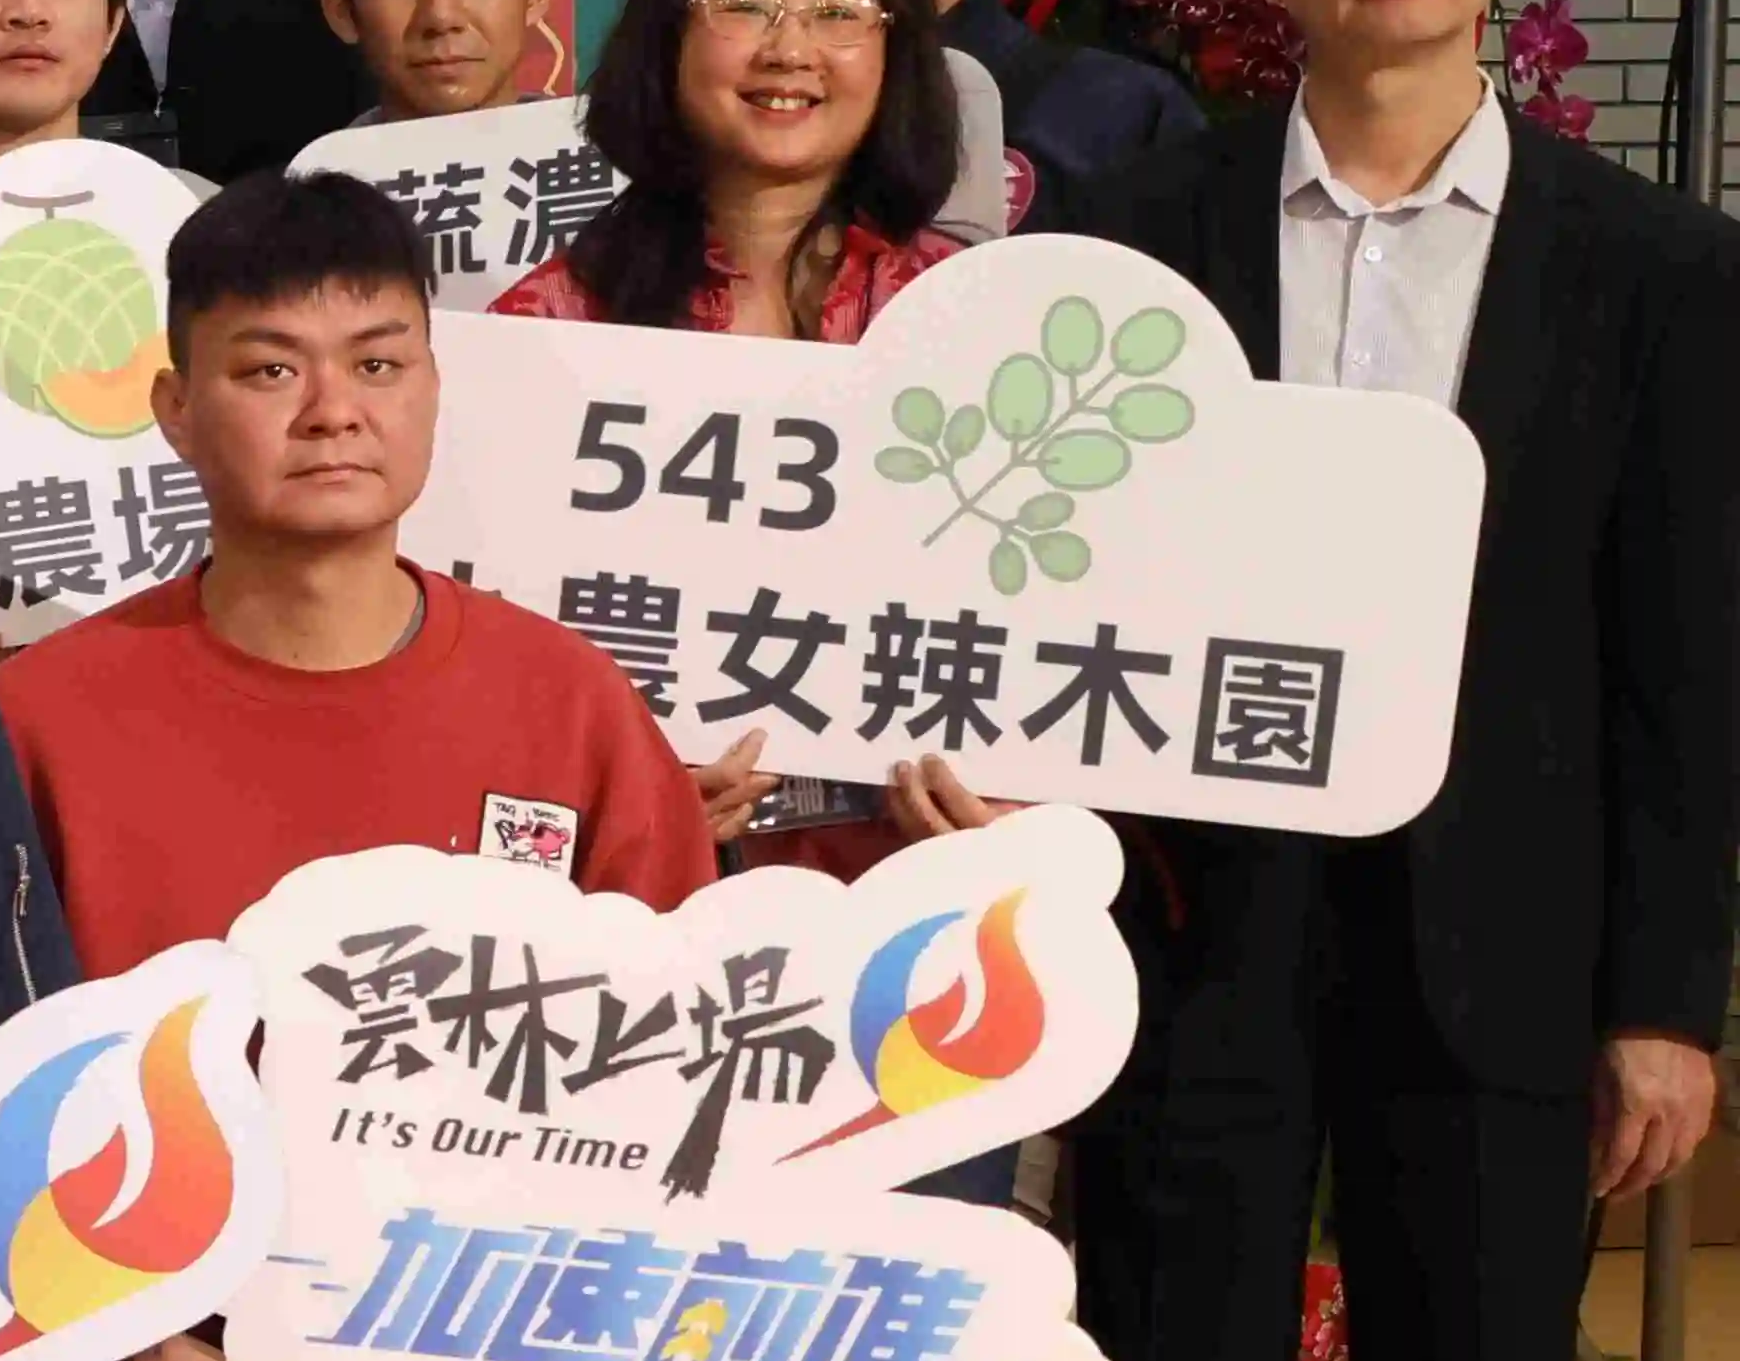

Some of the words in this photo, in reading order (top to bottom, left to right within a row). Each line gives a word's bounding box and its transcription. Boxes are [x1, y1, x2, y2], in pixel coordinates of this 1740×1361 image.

[568, 399, 842, 533] 543
[448, 558, 1345, 791] 農女辣木園
[301, 924, 836, 1204] 雲林上場
[332, 1107, 416, 1151] It's
[429, 1117, 523, 1160] Our
[531, 1126, 649, 1173] Time
